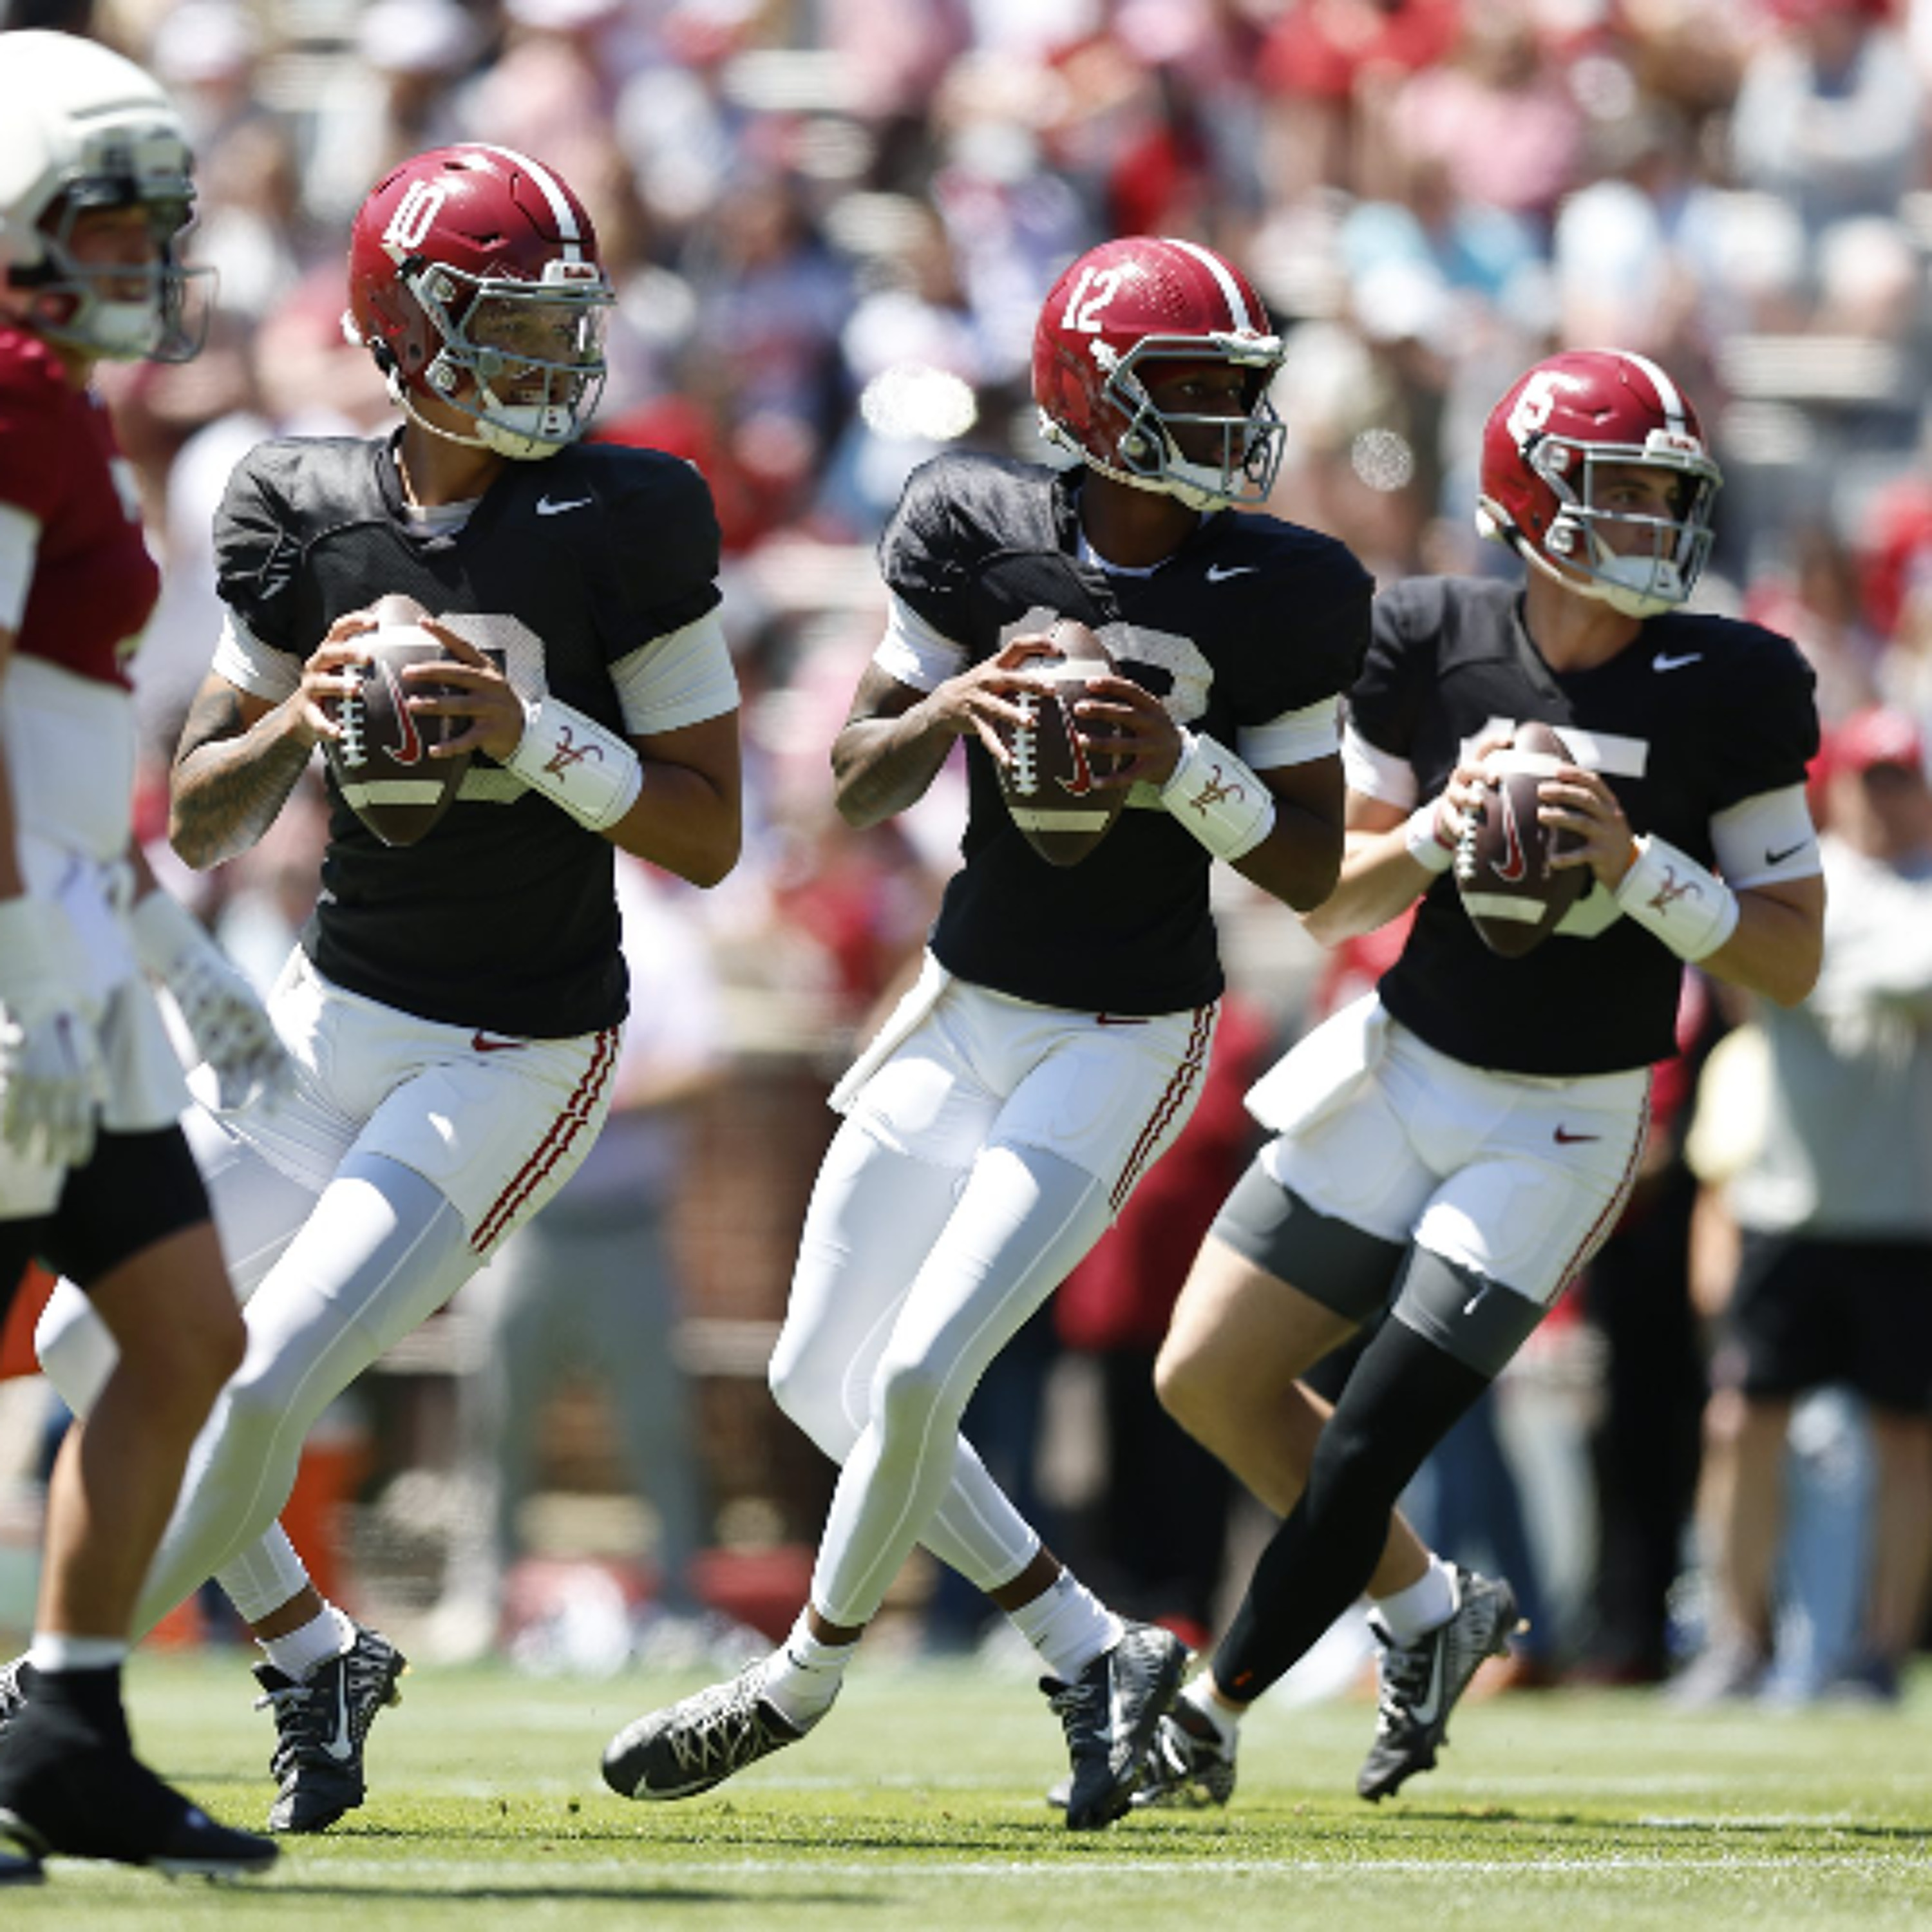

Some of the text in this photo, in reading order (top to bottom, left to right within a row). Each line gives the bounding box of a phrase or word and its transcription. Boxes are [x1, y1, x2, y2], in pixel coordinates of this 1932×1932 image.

[383, 180, 448, 249] 10
[1061, 265, 1121, 332] 12
[1506, 372, 1582, 439] 5
